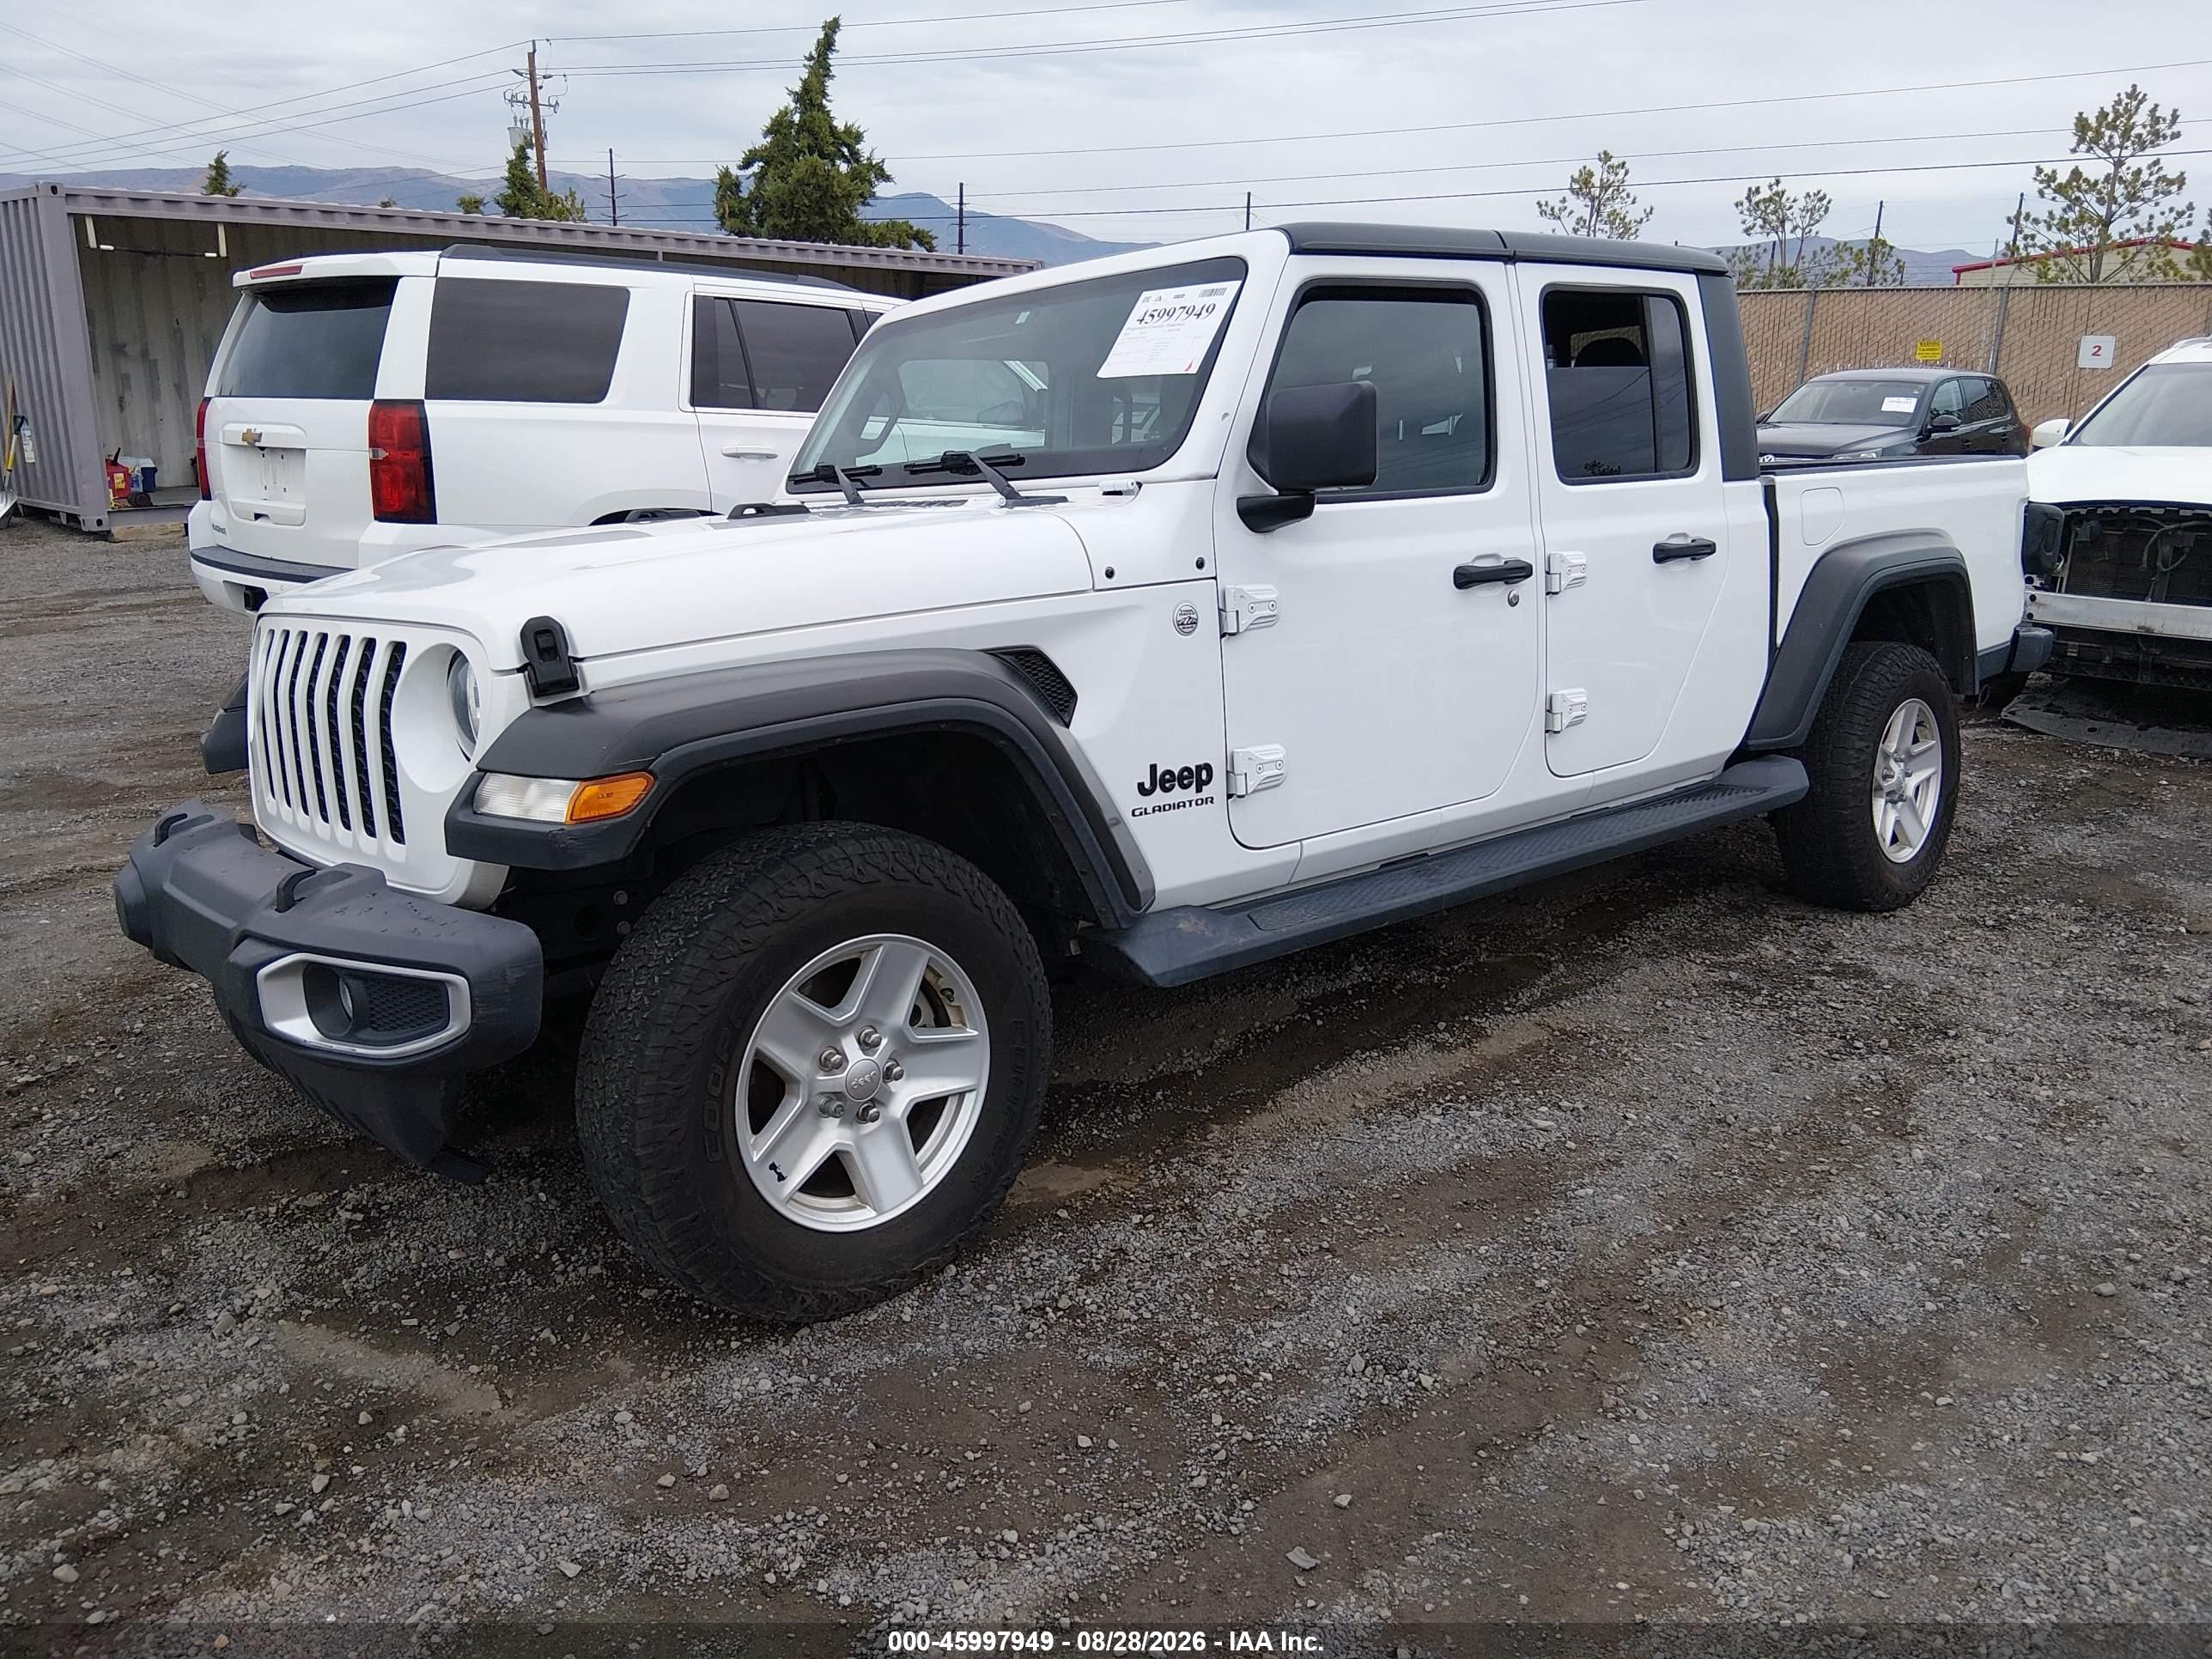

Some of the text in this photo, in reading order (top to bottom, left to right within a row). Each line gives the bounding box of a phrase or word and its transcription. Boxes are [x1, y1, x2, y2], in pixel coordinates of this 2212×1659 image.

[1136, 302, 1217, 325] 45997949
[2091, 344, 2102, 357] 2
[1137, 762, 1214, 797] Jeep
[1131, 797, 1215, 818] GLADIATOR
